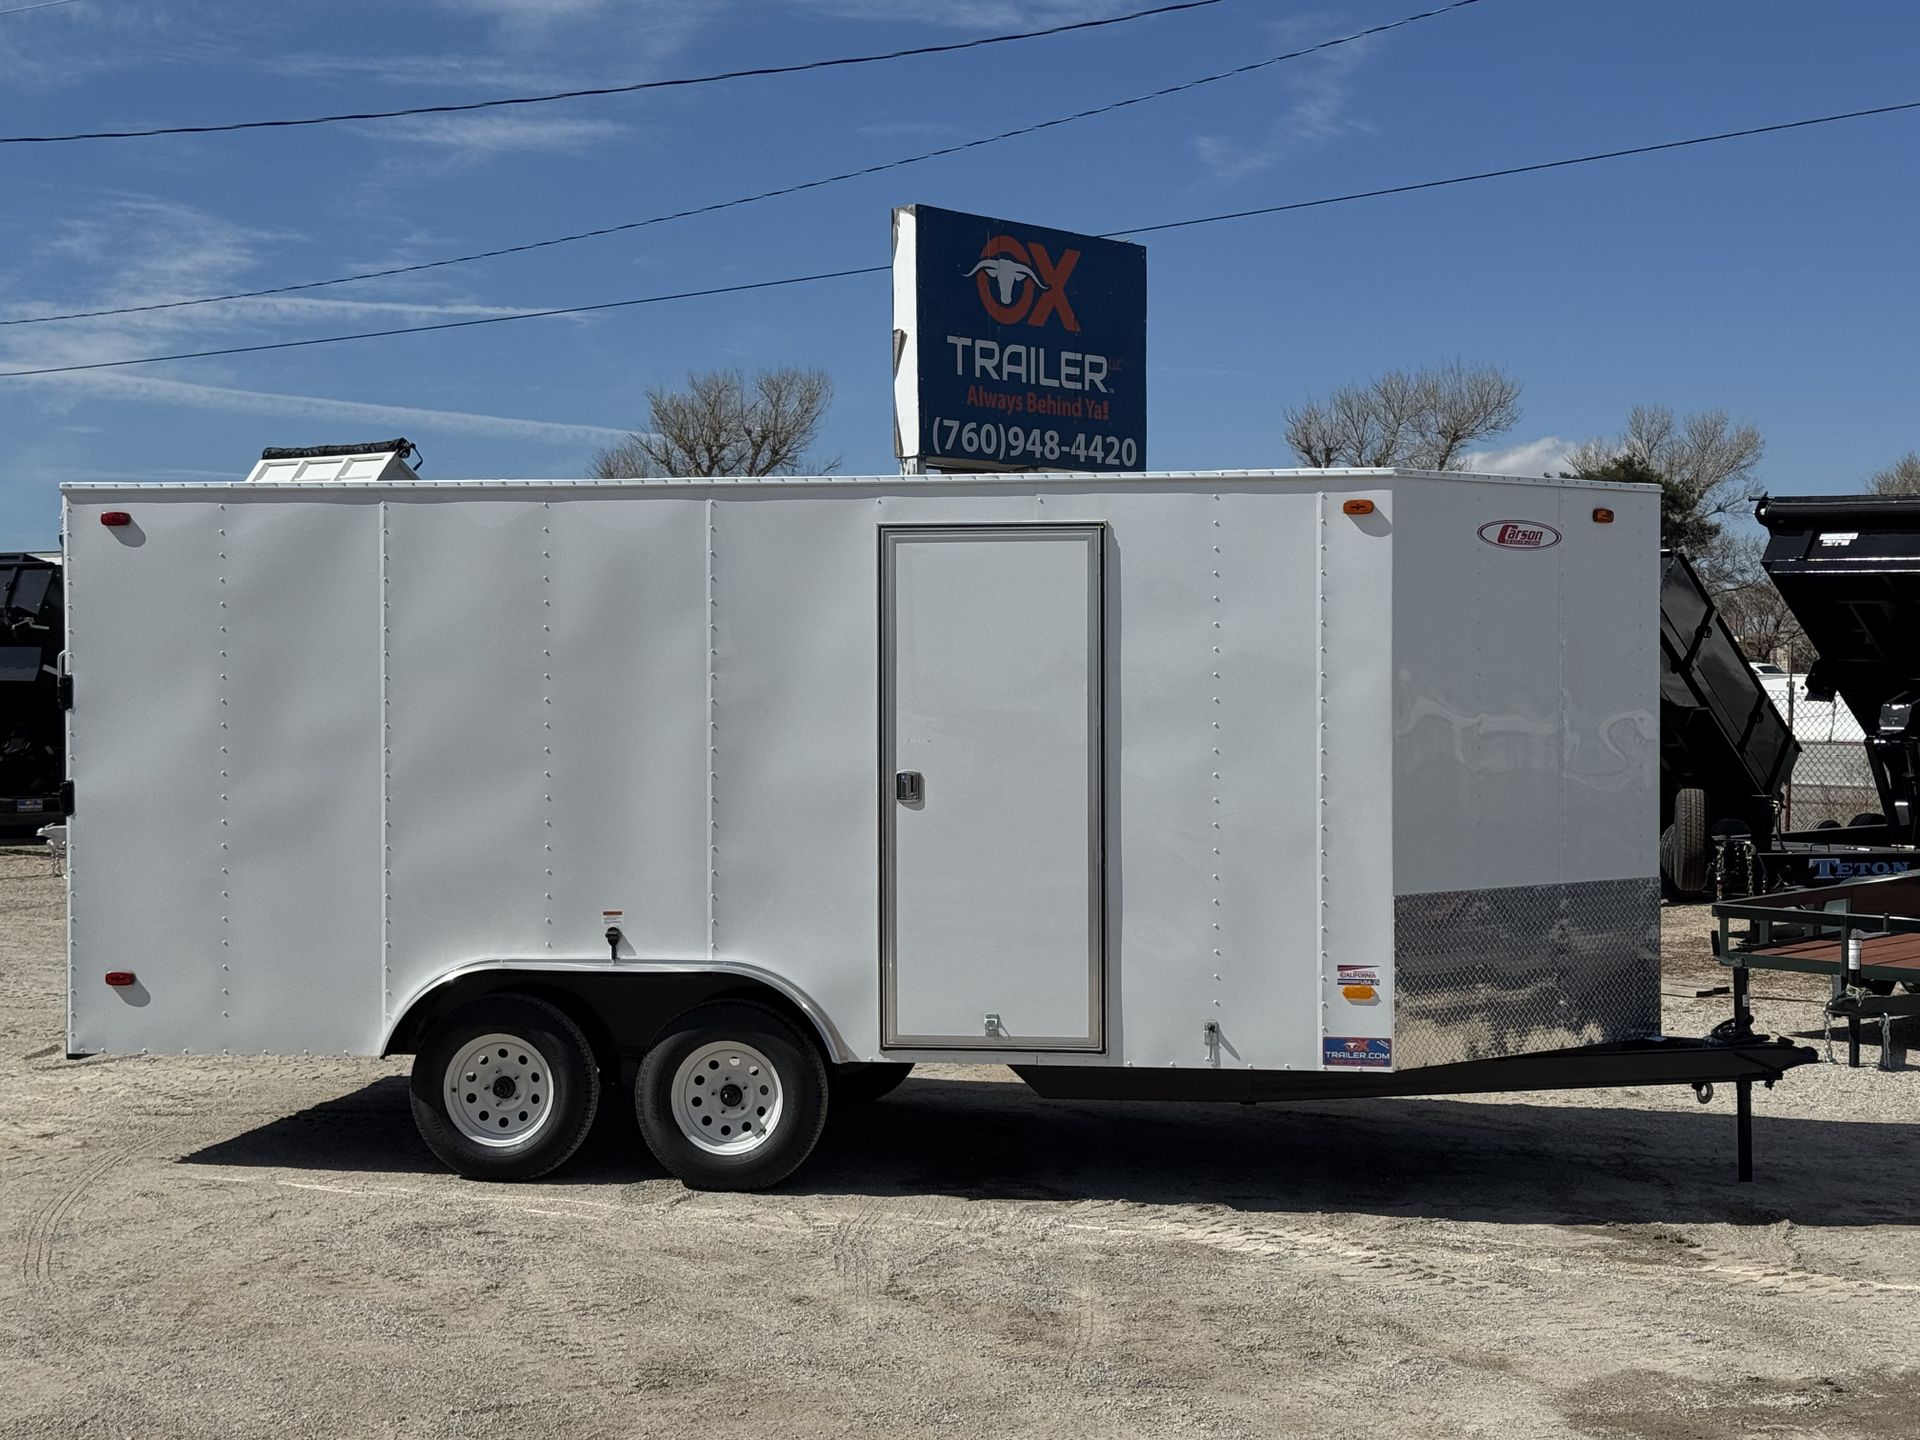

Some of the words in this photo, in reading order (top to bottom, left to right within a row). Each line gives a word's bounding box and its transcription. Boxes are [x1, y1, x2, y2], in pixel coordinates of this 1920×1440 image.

[976, 235, 1080, 332] OX
[946, 335, 1108, 393] TRAILER
[967, 385, 1022, 415] Always
[1027, 391, 1081, 417] Behind
[1085, 397, 1110, 420] Ya!
[932, 416, 1137, 467] (760)948-4420
[1497, 524, 1544, 544] Carson
[1326, 1051, 1390, 1059] TRAILER.COM
